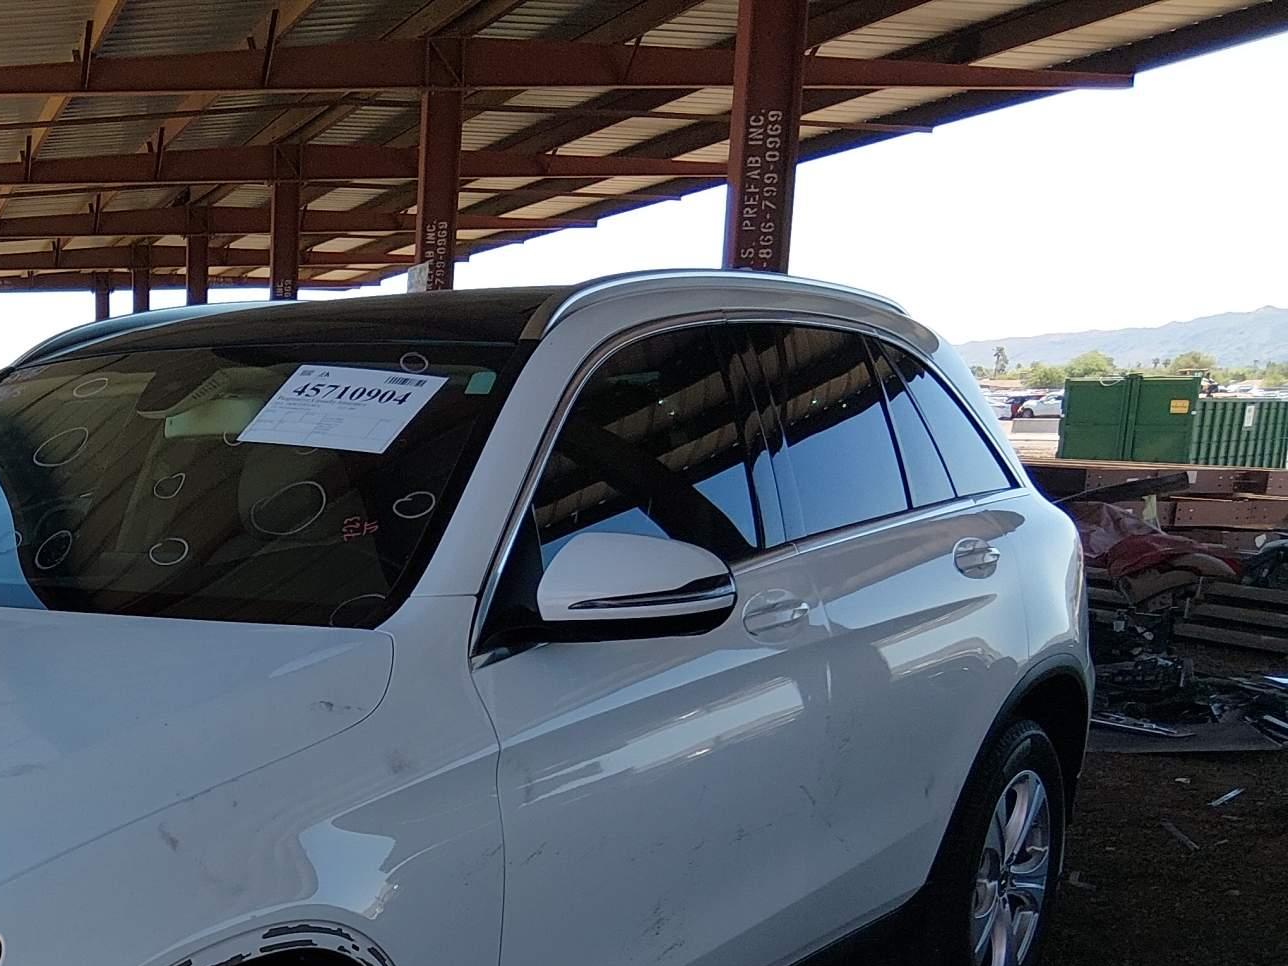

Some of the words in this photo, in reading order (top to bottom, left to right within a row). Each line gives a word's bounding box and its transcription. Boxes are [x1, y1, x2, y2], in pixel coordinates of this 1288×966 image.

[747, 108, 765, 145] INC.
[741, 156, 761, 230] PREFAB
[758, 110, 783, 268] -866-799-0969
[425, 215, 437, 246] INC.
[740, 241, 756, 265] .S.
[292, 382, 412, 405] 45710904
